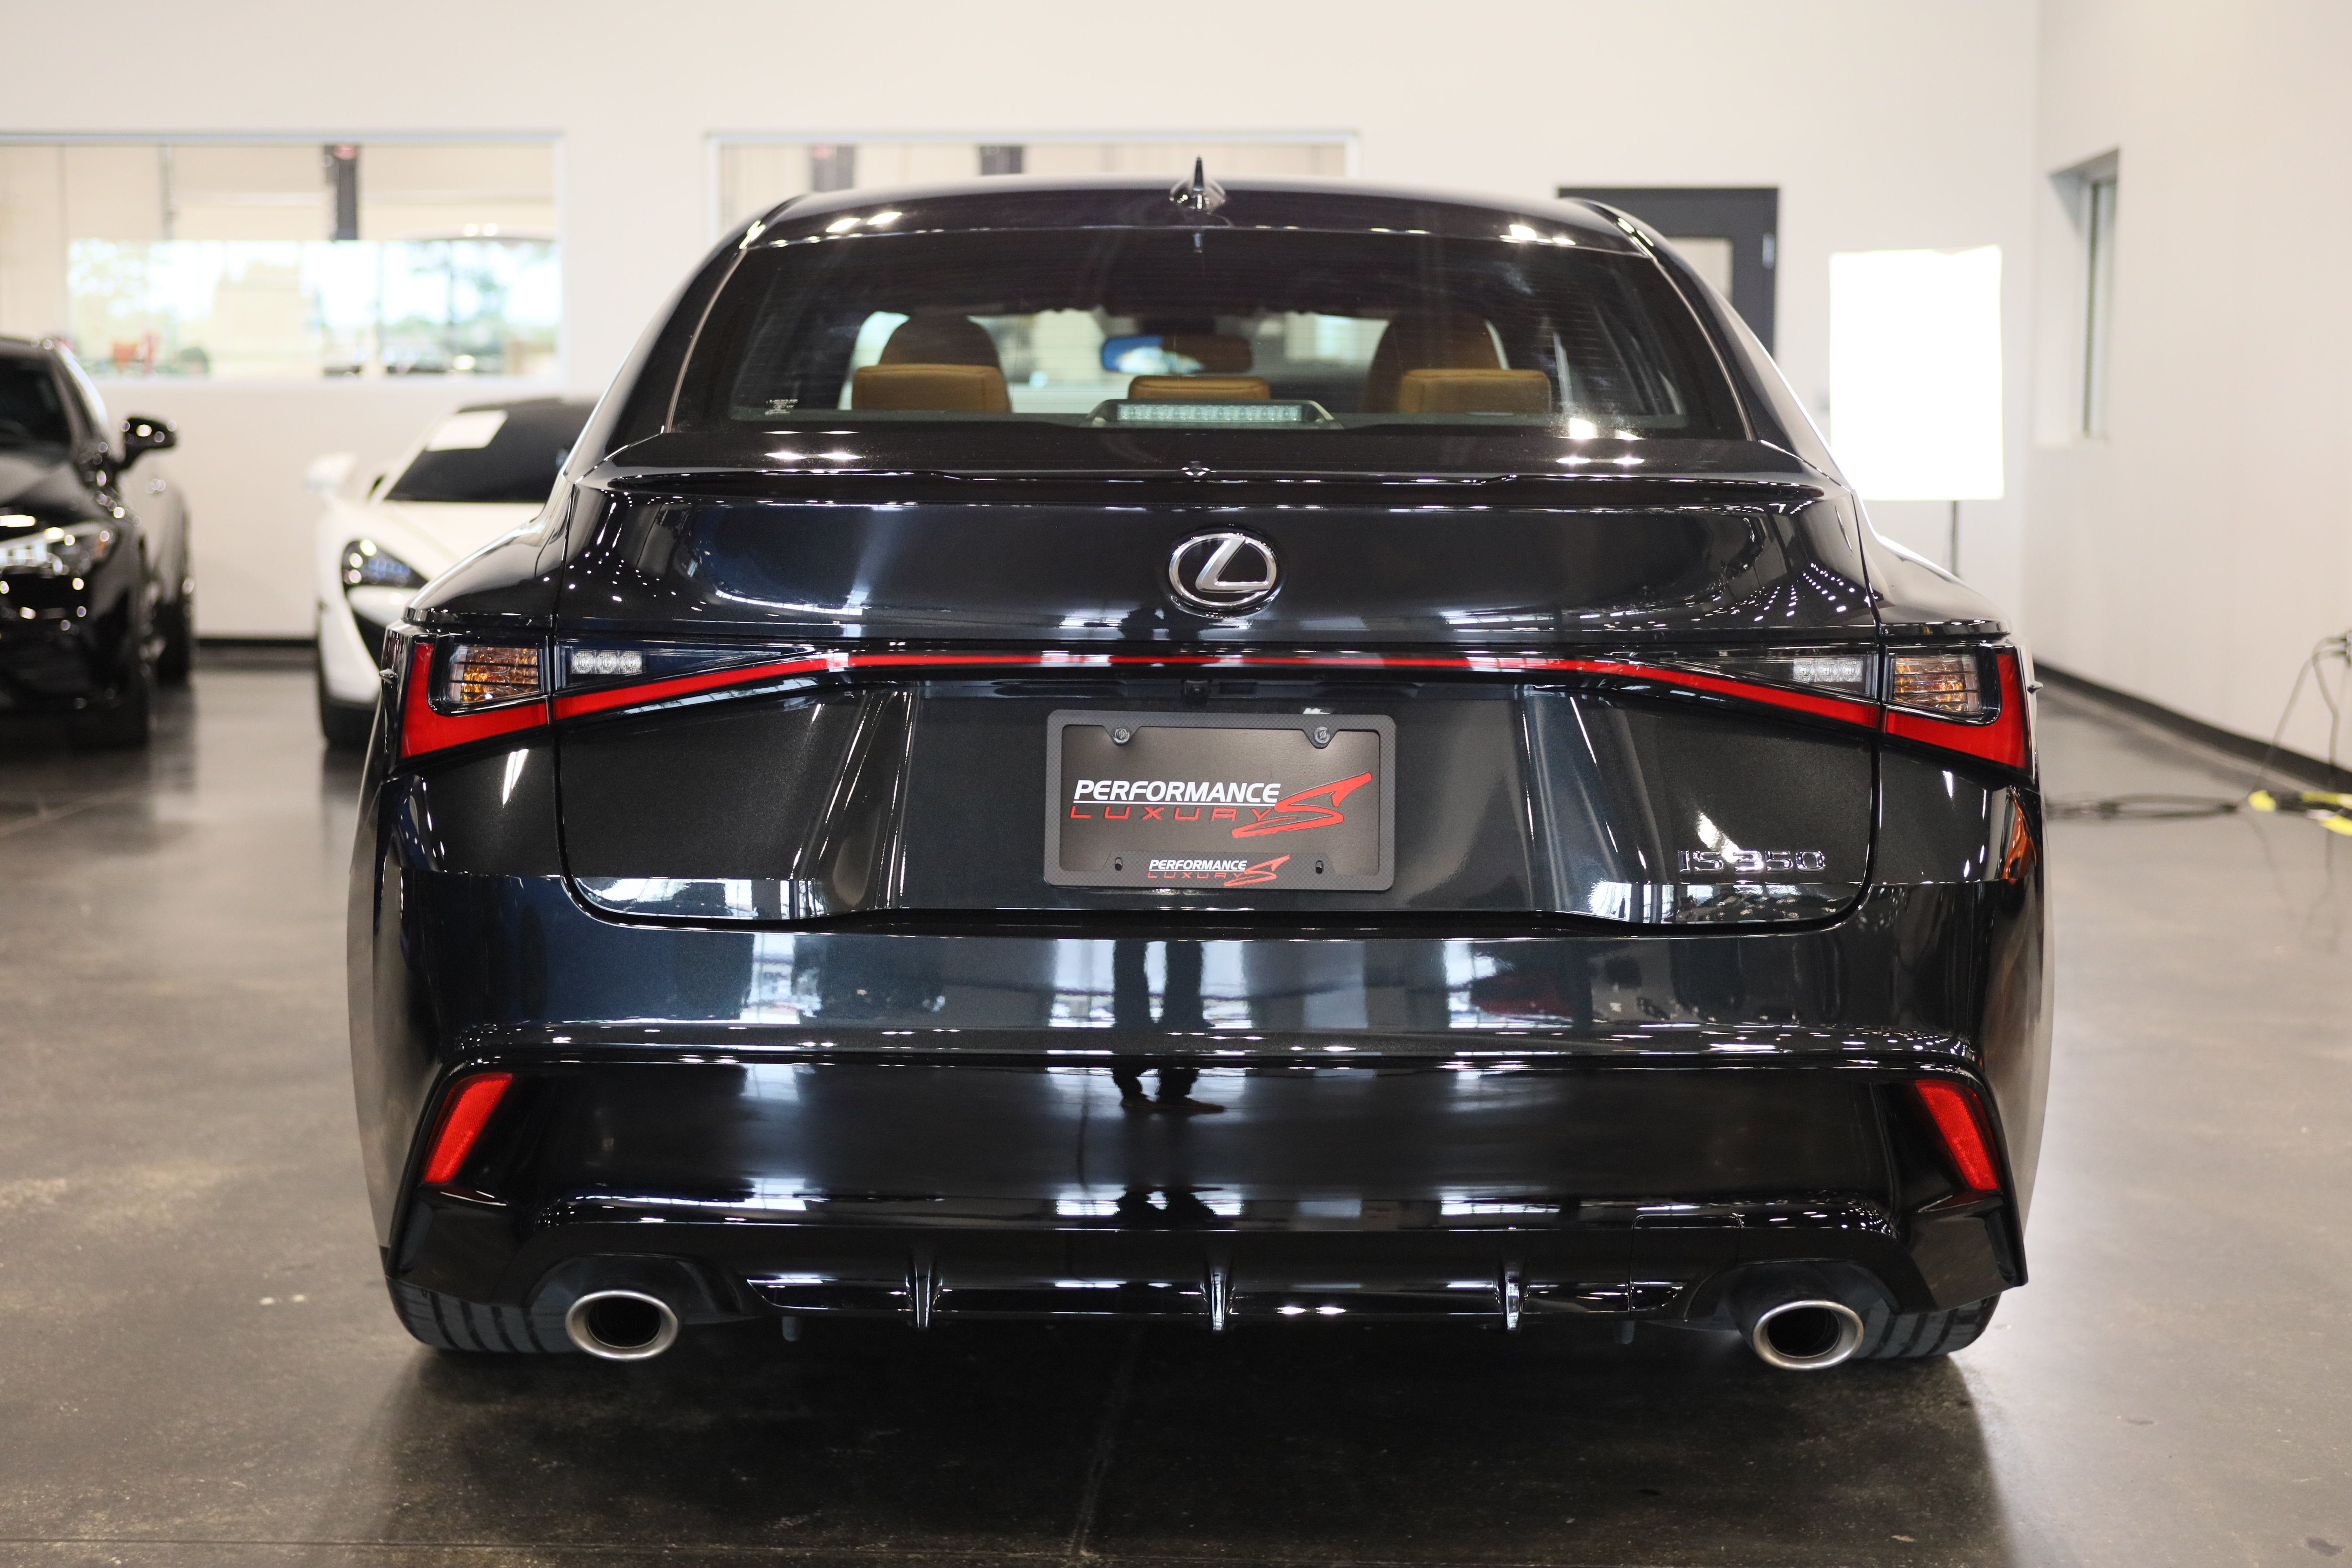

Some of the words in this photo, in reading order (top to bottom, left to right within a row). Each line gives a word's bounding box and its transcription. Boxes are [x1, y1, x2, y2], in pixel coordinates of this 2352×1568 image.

[1074, 780, 1281, 804] PERFORMANCE
[1149, 859, 1247, 870] PERFORMANCE
[1677, 850, 1724, 872] IS
[1732, 850, 1826, 872] 350
